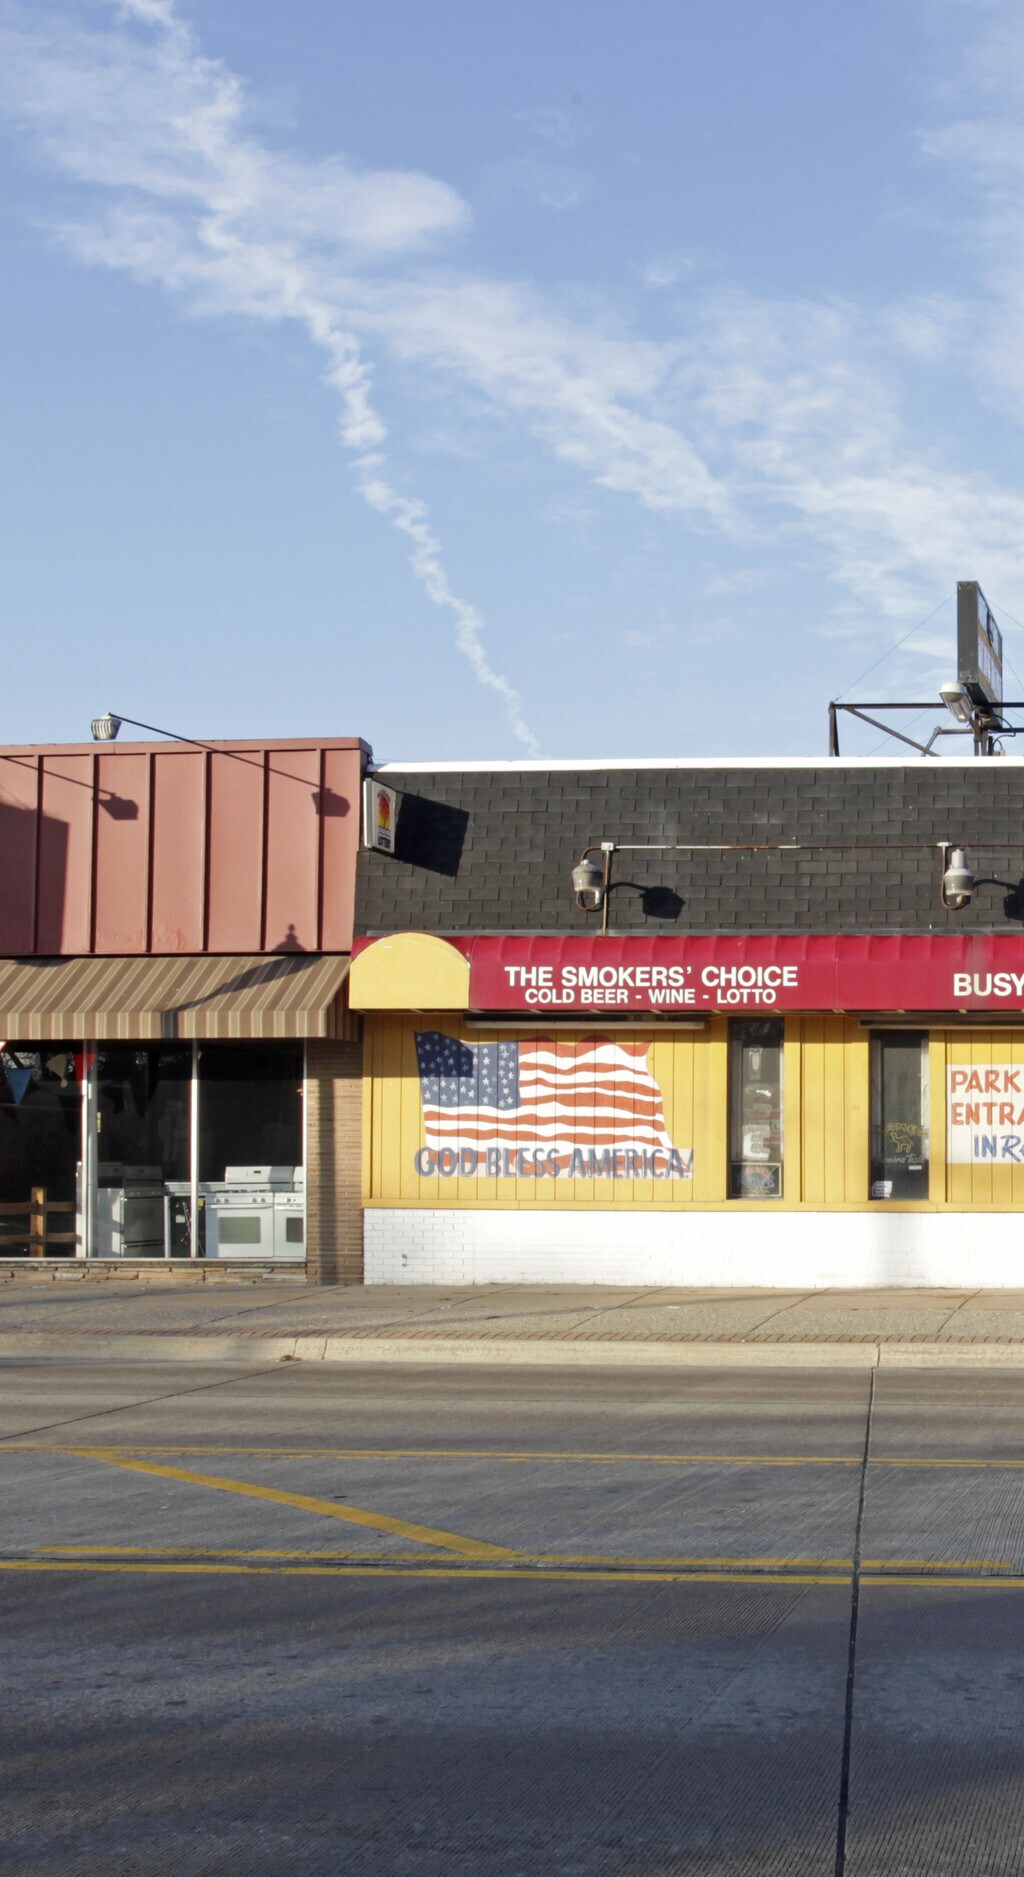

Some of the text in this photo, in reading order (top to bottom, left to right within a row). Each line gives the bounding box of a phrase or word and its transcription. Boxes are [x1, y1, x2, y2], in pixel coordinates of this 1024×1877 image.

[504, 965, 798, 987] THE SMOKERS' CHOICE
[525, 988, 575, 1004] COLD
[580, 988, 629, 1004] BEER
[648, 988, 696, 1004] WINE
[717, 988, 776, 1004] LOTTO
[973, 1133, 998, 1159] IN
[414, 1146, 694, 1179] GOD BLESS AMERICA!
